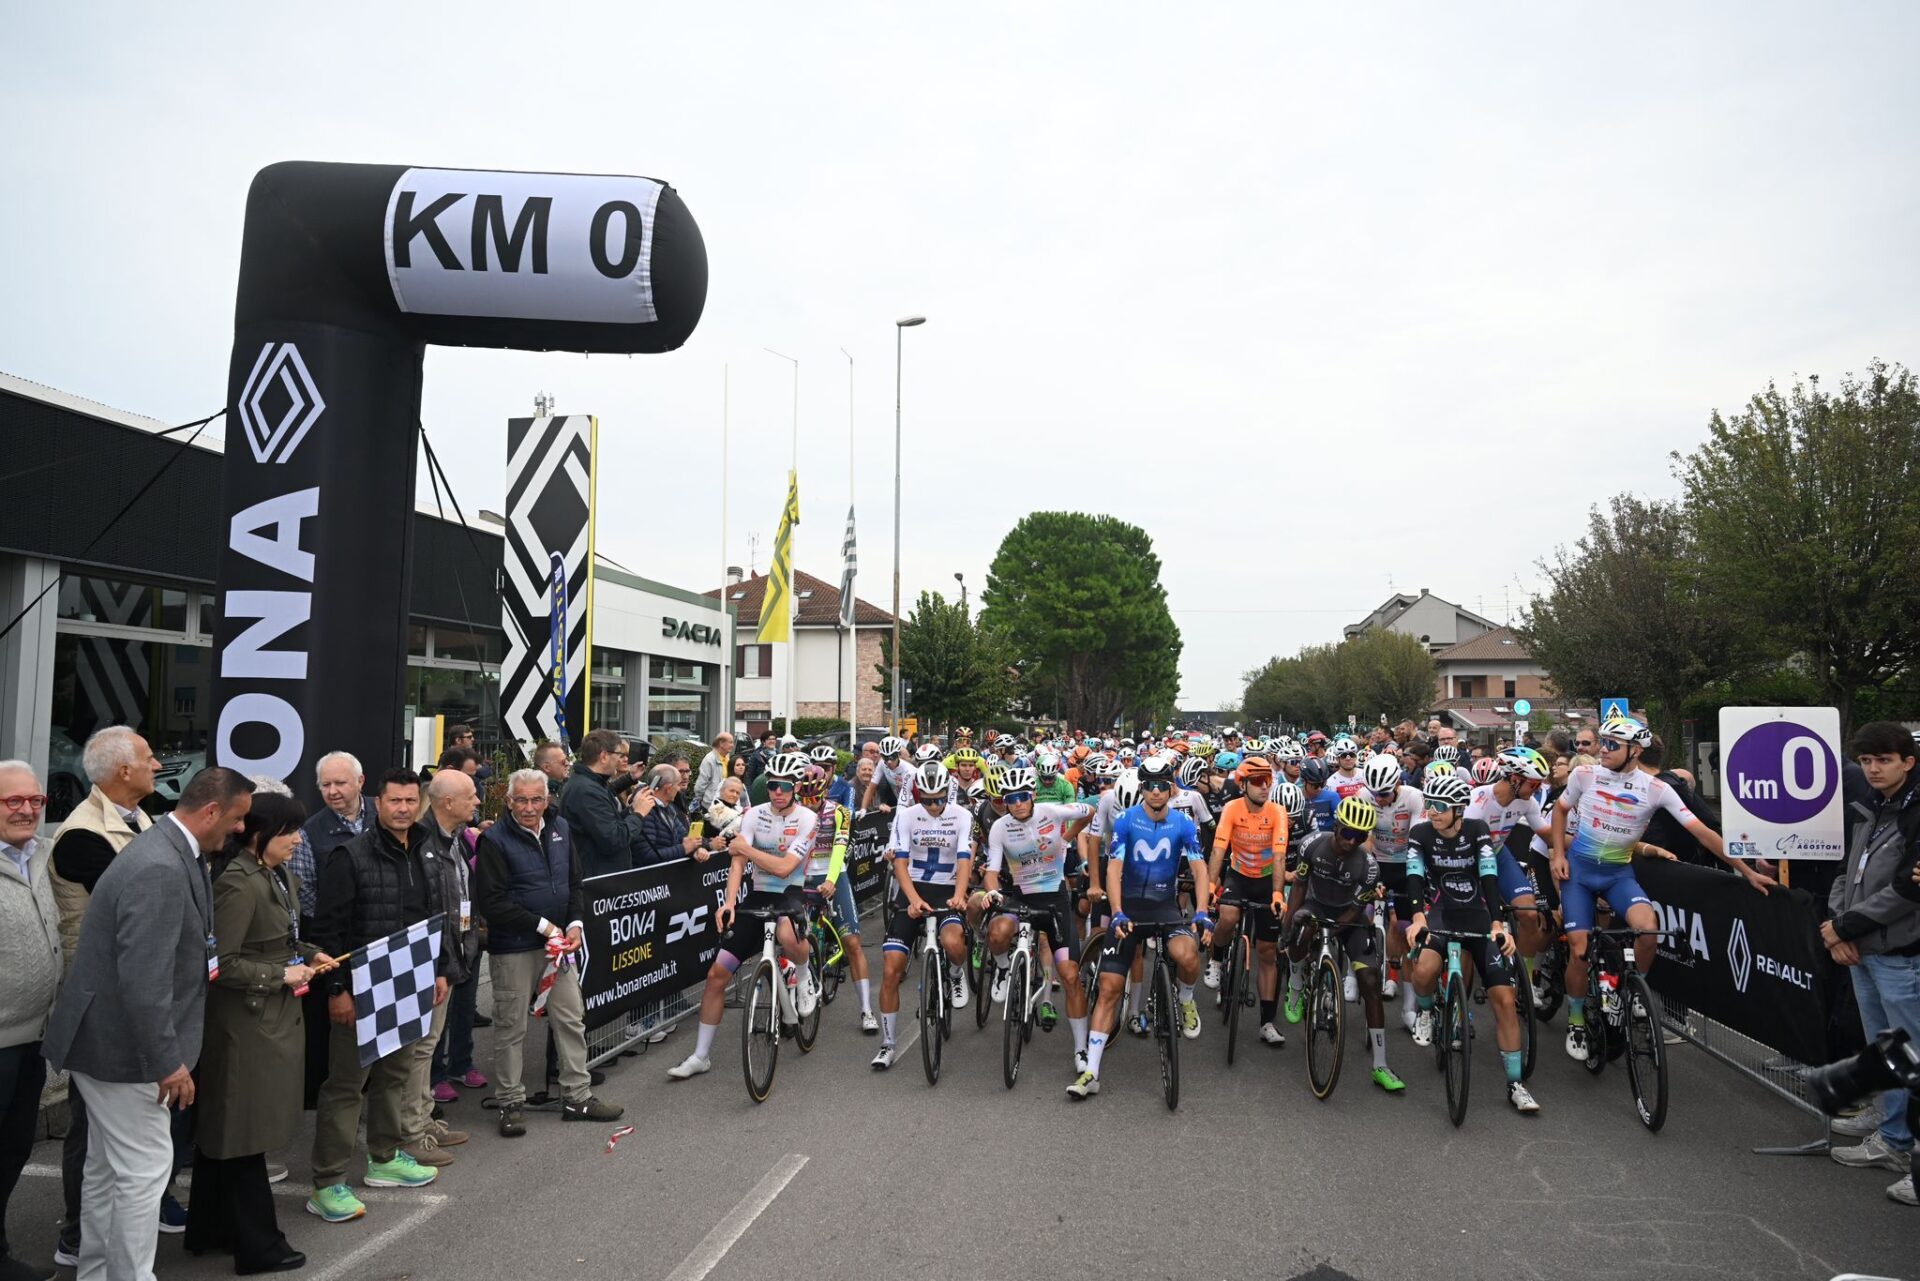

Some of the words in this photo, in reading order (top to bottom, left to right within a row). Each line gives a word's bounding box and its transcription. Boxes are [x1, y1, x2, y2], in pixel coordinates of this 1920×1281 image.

[393, 191, 552, 275] KM
[589, 200, 643, 279] 0
[215, 486, 320, 783] ONA
[662, 617, 721, 648] DACIA
[1739, 773, 1778, 800] km
[1782, 736, 1827, 801] 0
[593, 884, 671, 916] CONCESSIONARIA
[609, 909, 656, 946] BONA
[612, 942, 652, 972] LISSONE
[1756, 954, 1813, 990] RENAULT
[586, 960, 678, 1010] www.bonarenault.it
